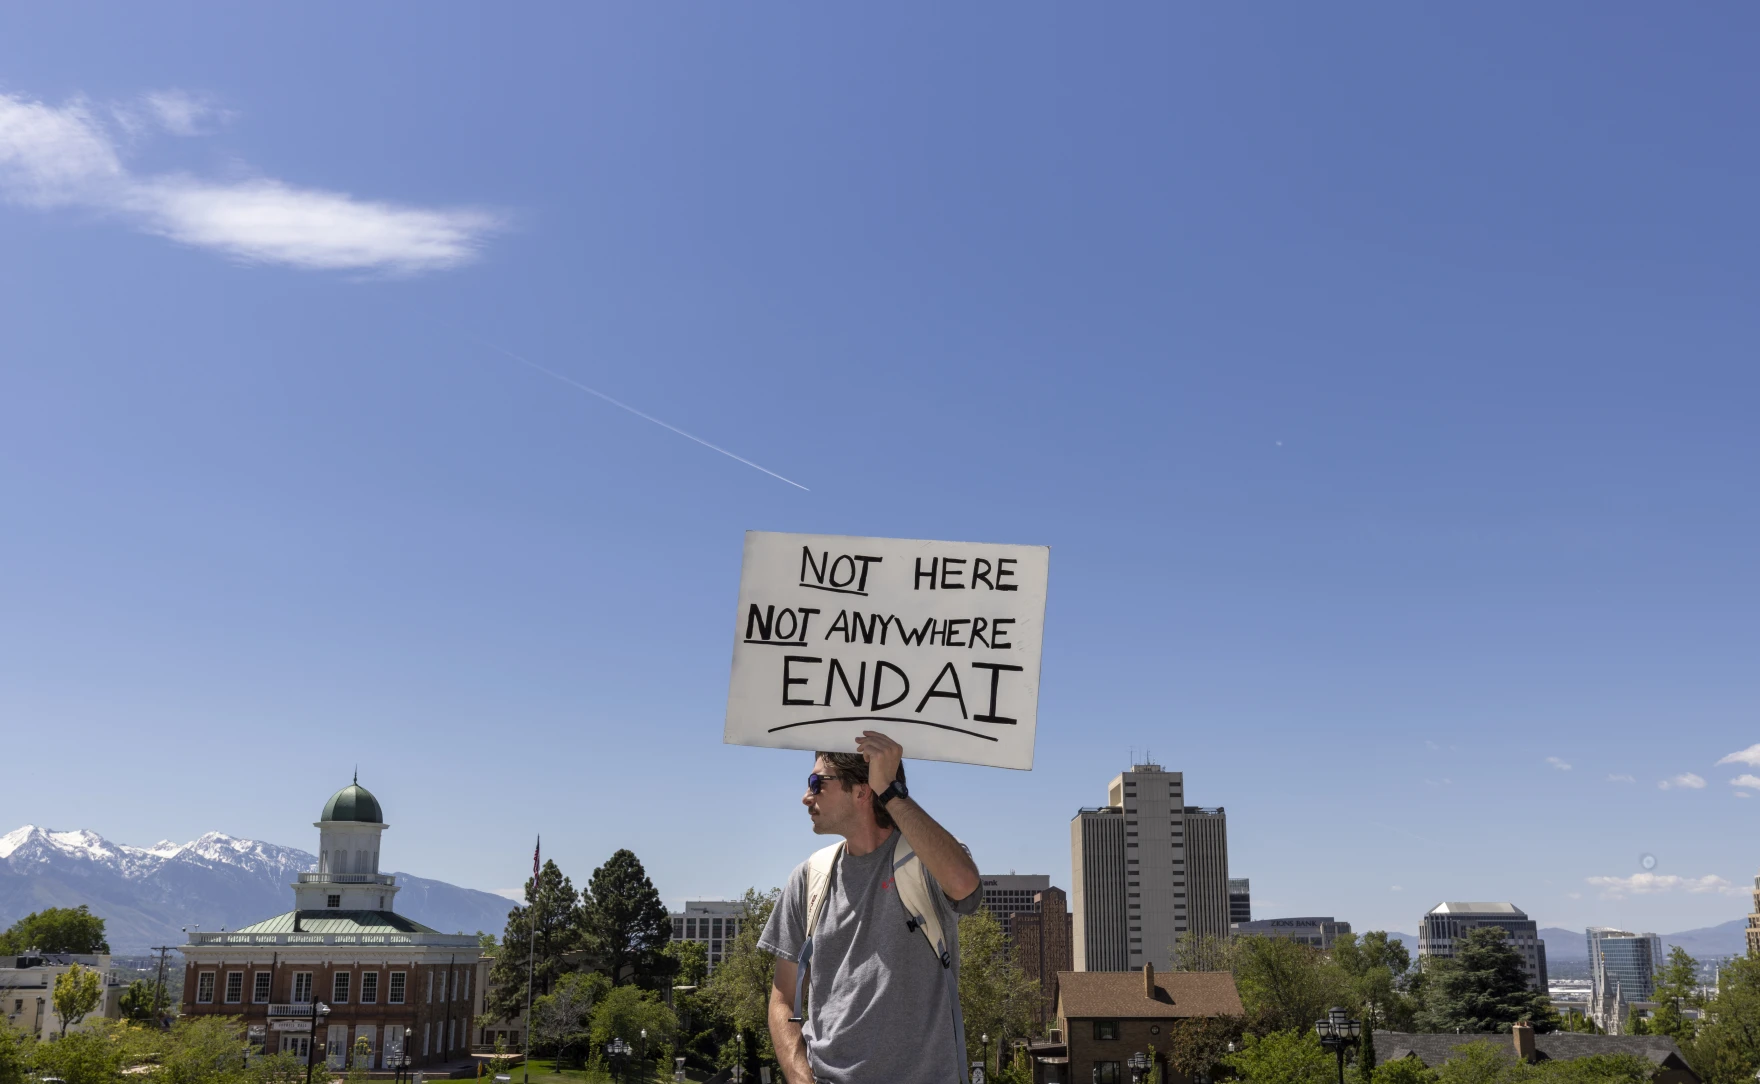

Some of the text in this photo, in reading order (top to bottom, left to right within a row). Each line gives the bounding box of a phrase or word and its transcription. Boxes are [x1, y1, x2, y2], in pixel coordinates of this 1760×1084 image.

[800, 545, 1018, 592] NOT HERE
[745, 603, 1016, 649] NOT ANYWHERE
[782, 655, 1024, 725] END AI
